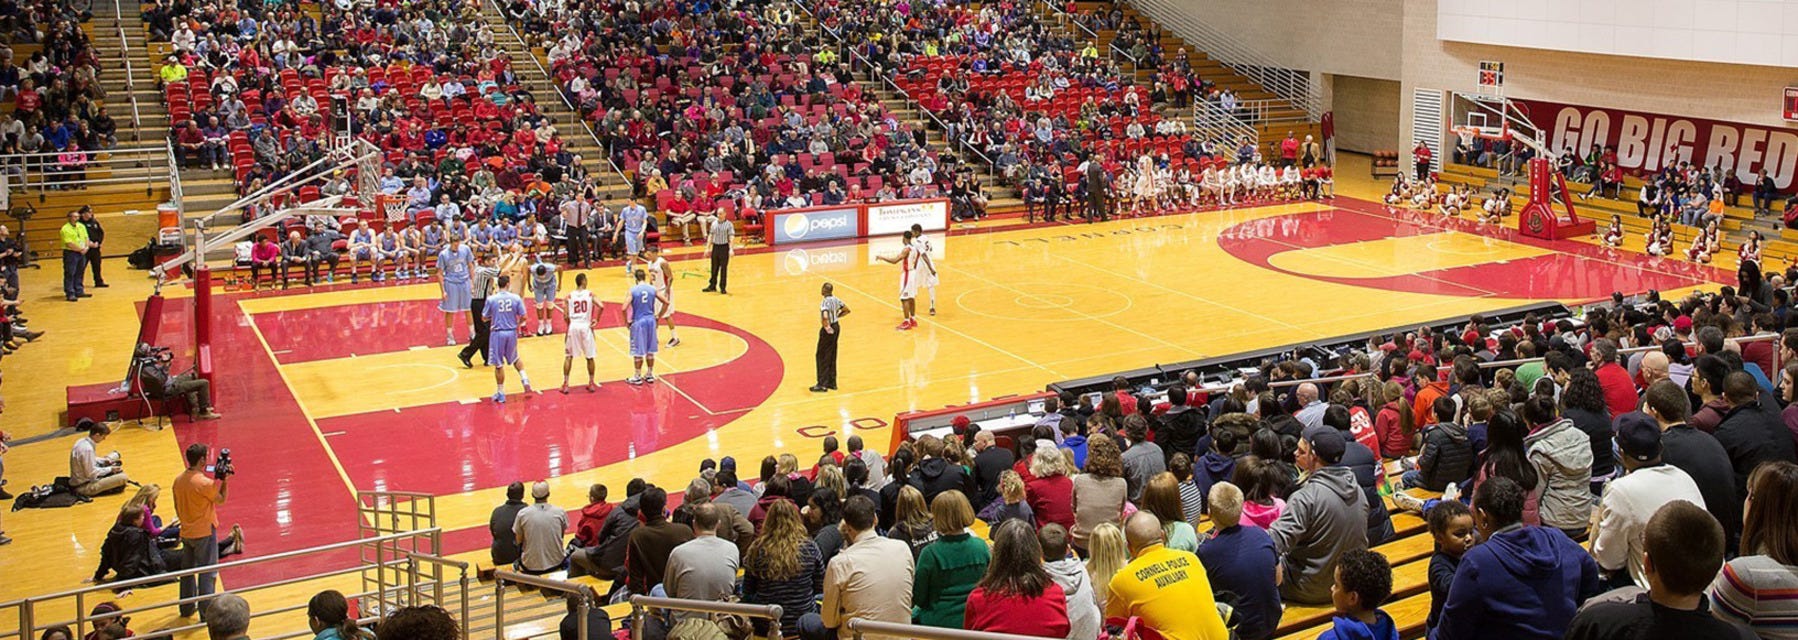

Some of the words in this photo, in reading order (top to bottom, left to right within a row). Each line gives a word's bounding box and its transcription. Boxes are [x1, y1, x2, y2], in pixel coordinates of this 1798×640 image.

[1551, 106, 1610, 163] GO
[1616, 114, 1697, 172] BIG
[1704, 124, 1798, 189] RED
[810, 214, 848, 232] pepsi
[497, 299, 513, 313] 32
[641, 291, 648, 304] 2
[573, 300, 588, 314] 20
[1135, 562, 1169, 582] CORNELL
[1165, 556, 1190, 570] POLICE
[1154, 570, 1189, 589] AUXILIARY
